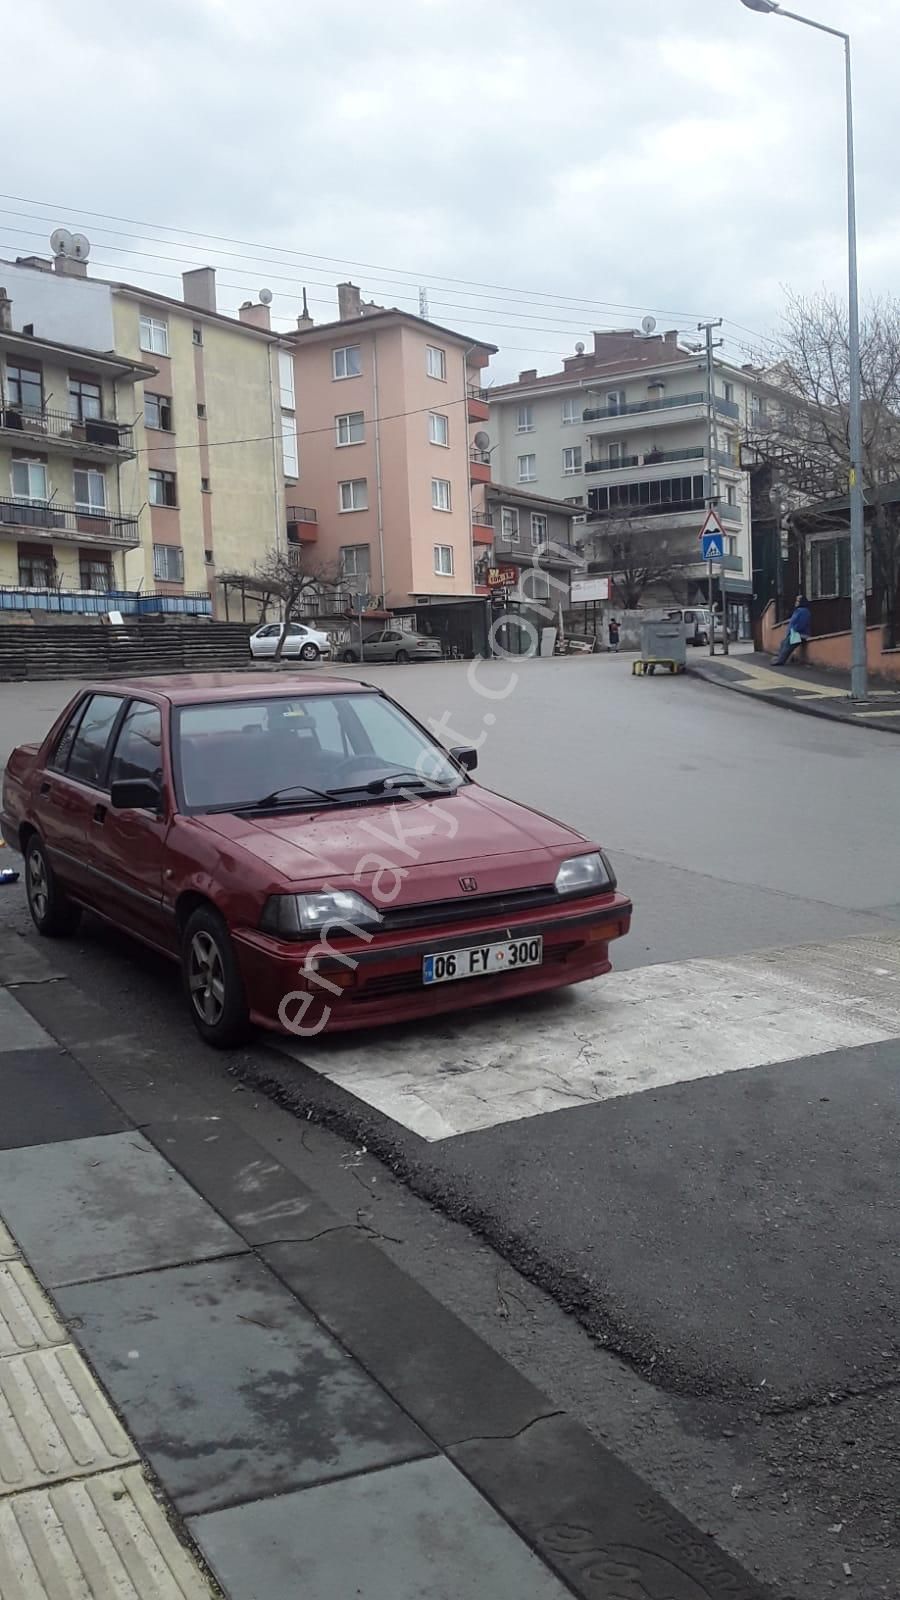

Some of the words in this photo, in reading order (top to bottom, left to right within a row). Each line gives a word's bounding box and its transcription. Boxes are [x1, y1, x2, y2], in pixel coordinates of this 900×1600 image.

[435, 955, 456, 978] 06
[469, 948, 490, 972] FY
[508, 941, 539, 965] 300
